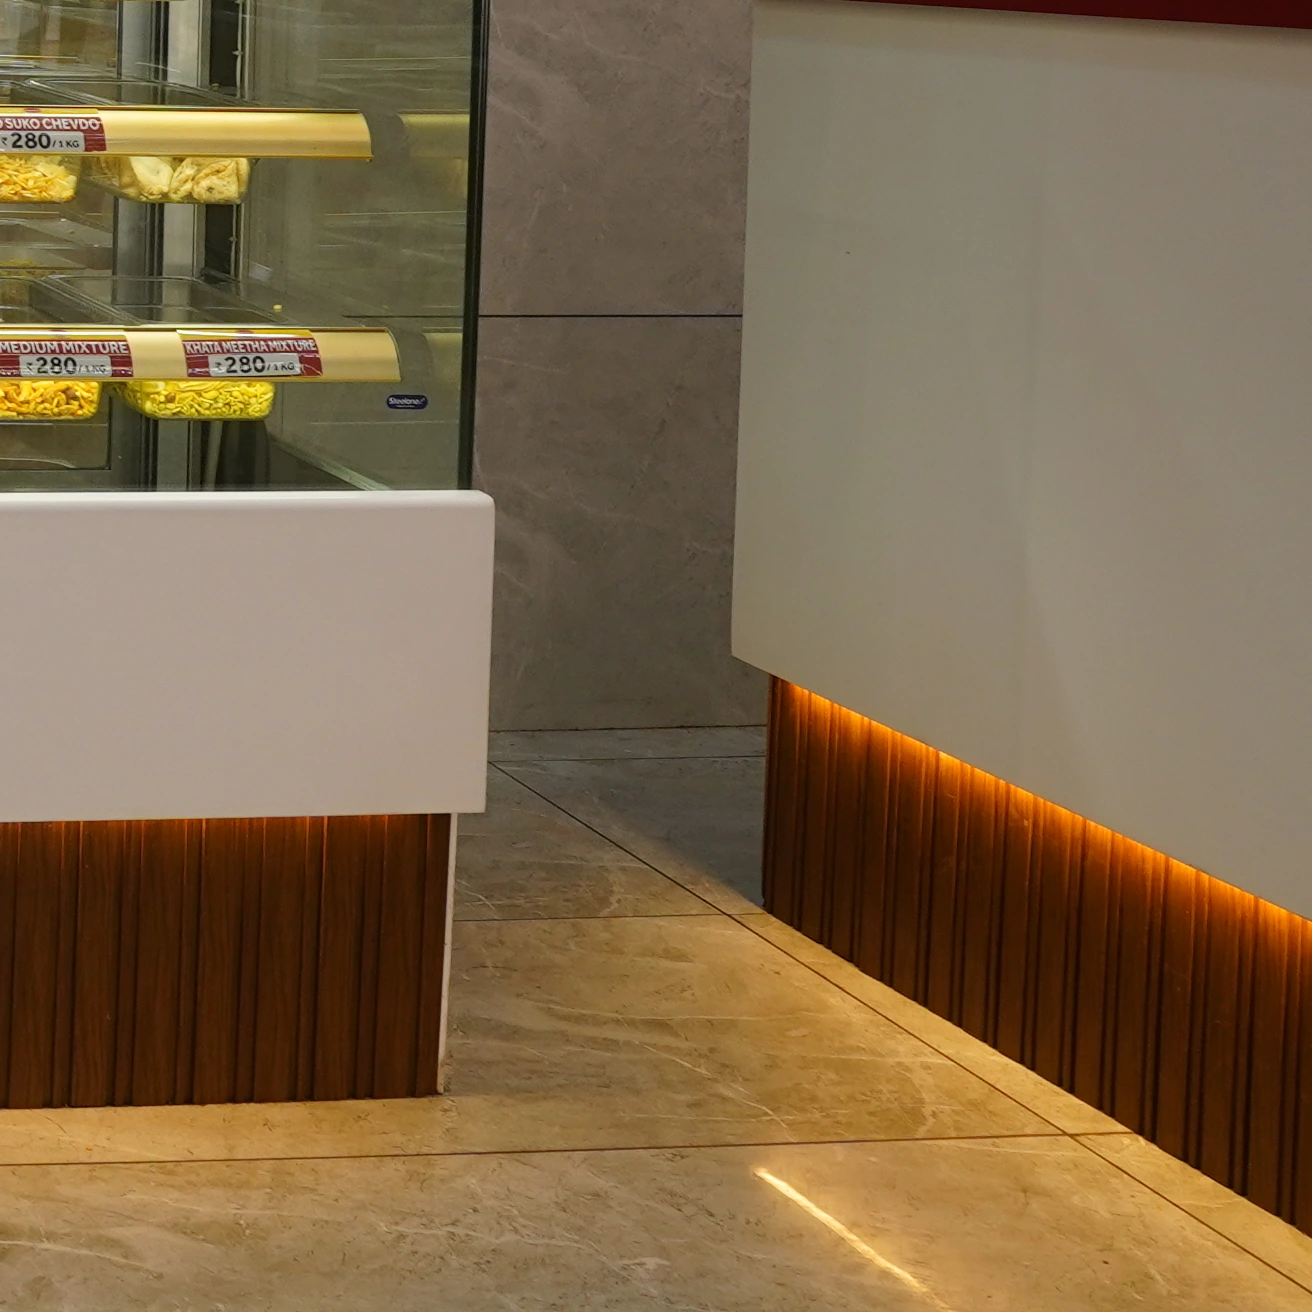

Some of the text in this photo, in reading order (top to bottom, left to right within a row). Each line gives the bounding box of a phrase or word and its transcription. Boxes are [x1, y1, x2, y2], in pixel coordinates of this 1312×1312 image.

[7, 118, 40, 130] SUKO
[44, 118, 100, 130] CHEVDO
[59, 342, 128, 354] MIXTURE
[186, 340, 317, 353] KHATA MEETHA MIXTURE
